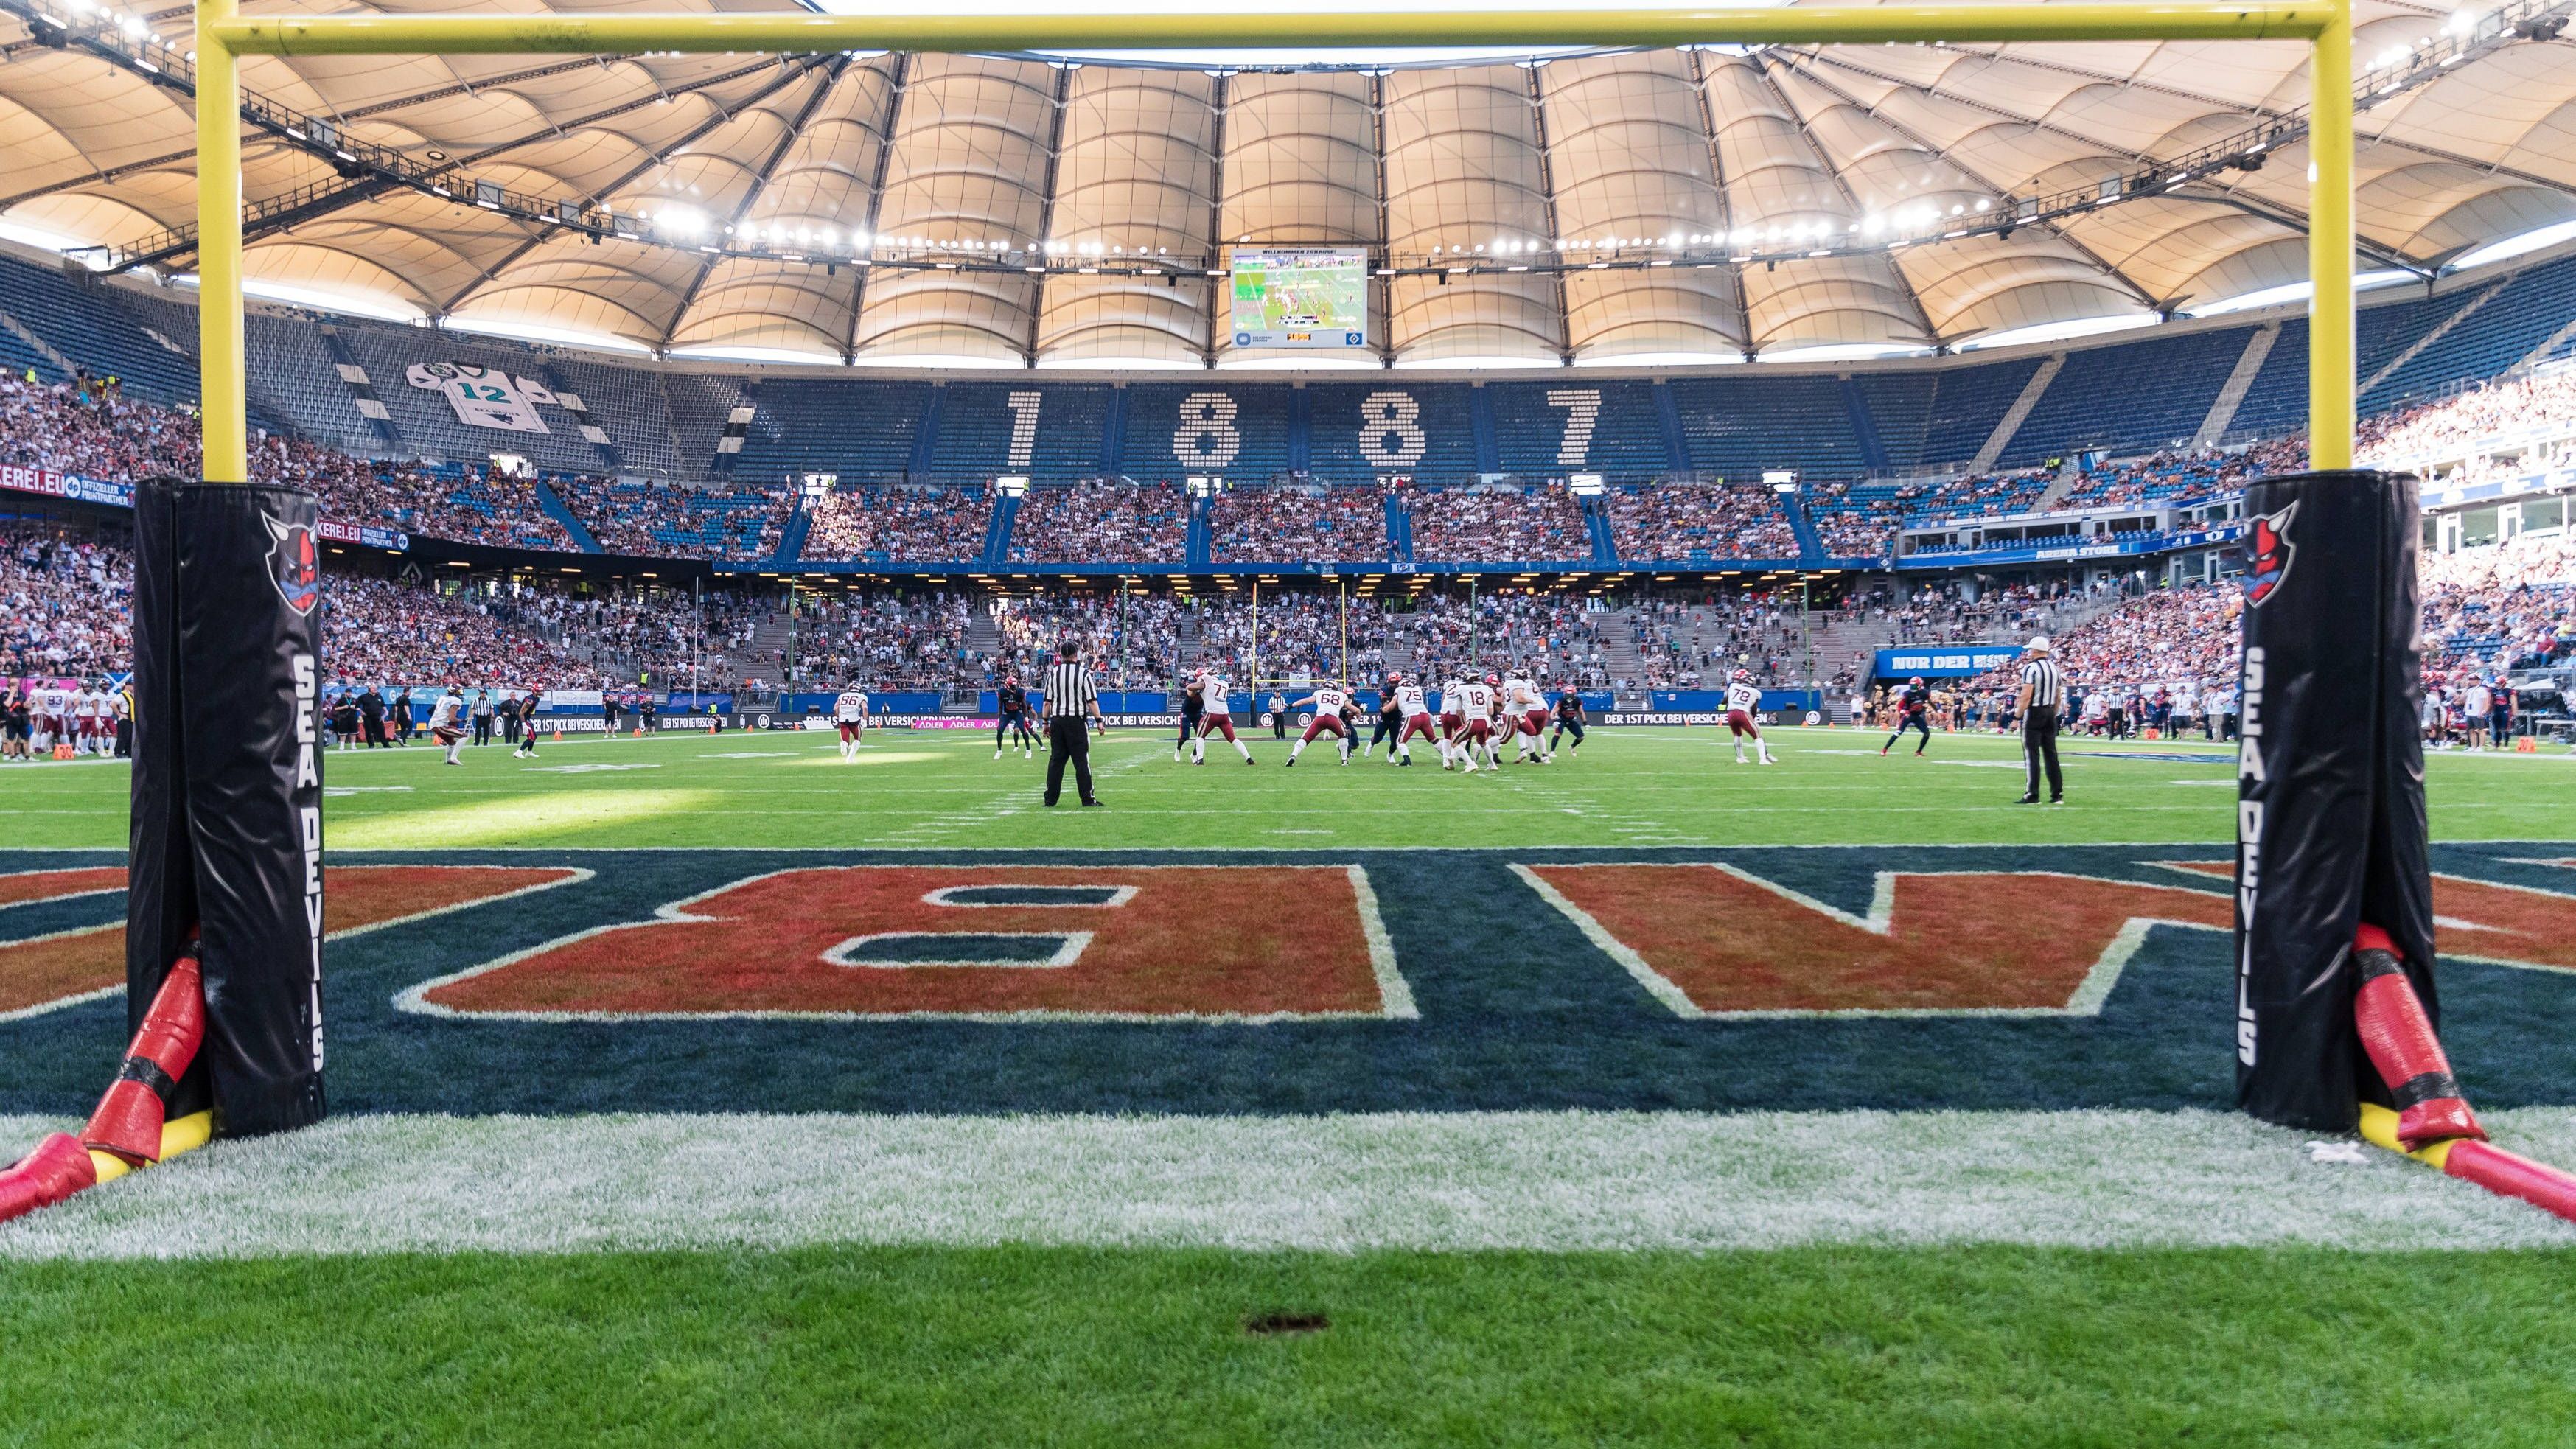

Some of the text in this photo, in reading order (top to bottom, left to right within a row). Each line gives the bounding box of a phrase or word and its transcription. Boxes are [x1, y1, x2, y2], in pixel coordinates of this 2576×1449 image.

[457, 382, 512, 404] 12
[0, 465, 66, 495] EREI.EU
[81, 479, 119, 495] OFFIZIELLER
[81, 491, 128, 506] PRINTPARTNER
[2036, 545, 2120, 559] ARENA STORE
[1892, 657, 1930, 670] NUR
[1933, 655, 1970, 669] DER
[1214, 683, 1227, 698] 77
[1405, 690, 1422, 702] 75
[1732, 688, 1751, 702] 78
[47, 695, 63, 705] 93
[840, 695, 858, 705] 86
[1320, 694, 1340, 705] 68
[1469, 691, 1485, 705] 18
[542, 719, 554, 732] 1ST
[554, 718, 567, 731] PICK
[568, 718, 576, 731] BEI
[576, 718, 621, 731] VERSICHEREN
[1122, 716, 1137, 726] BEI
[1605, 714, 1621, 724] DER
[1625, 713, 1643, 724] 1ST
[1644, 713, 1666, 724] PICK
[1667, 713, 1683, 724] BEI
[60, 746, 72, 758] 30
[293, 654, 324, 1073] SEA DEVILS
[2238, 646, 2266, 1067] SEA DEVILS
